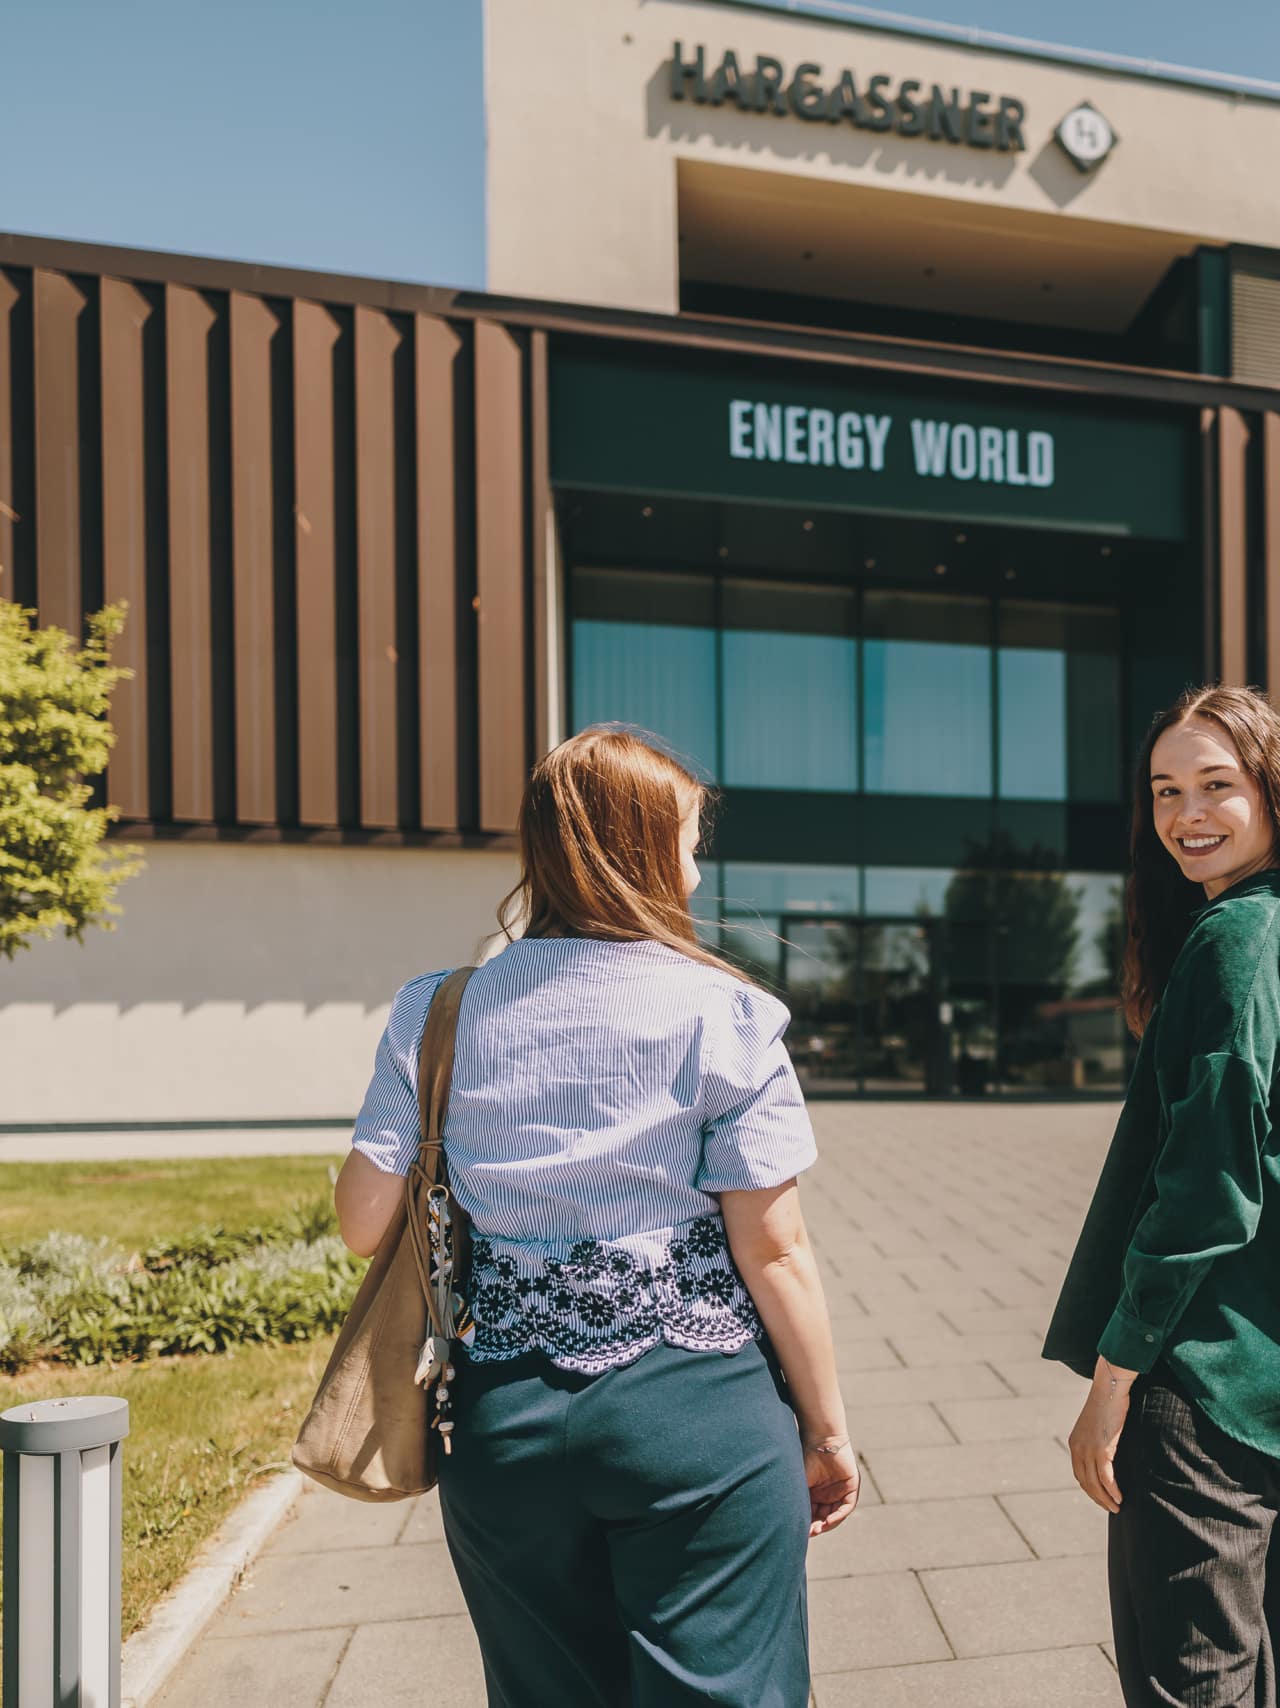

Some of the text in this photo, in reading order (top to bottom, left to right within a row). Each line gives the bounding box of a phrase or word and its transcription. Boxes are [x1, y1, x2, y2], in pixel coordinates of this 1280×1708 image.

[669, 39, 1028, 152] HARGASSNER
[729, 399, 1055, 488] ENERGY WORLD
